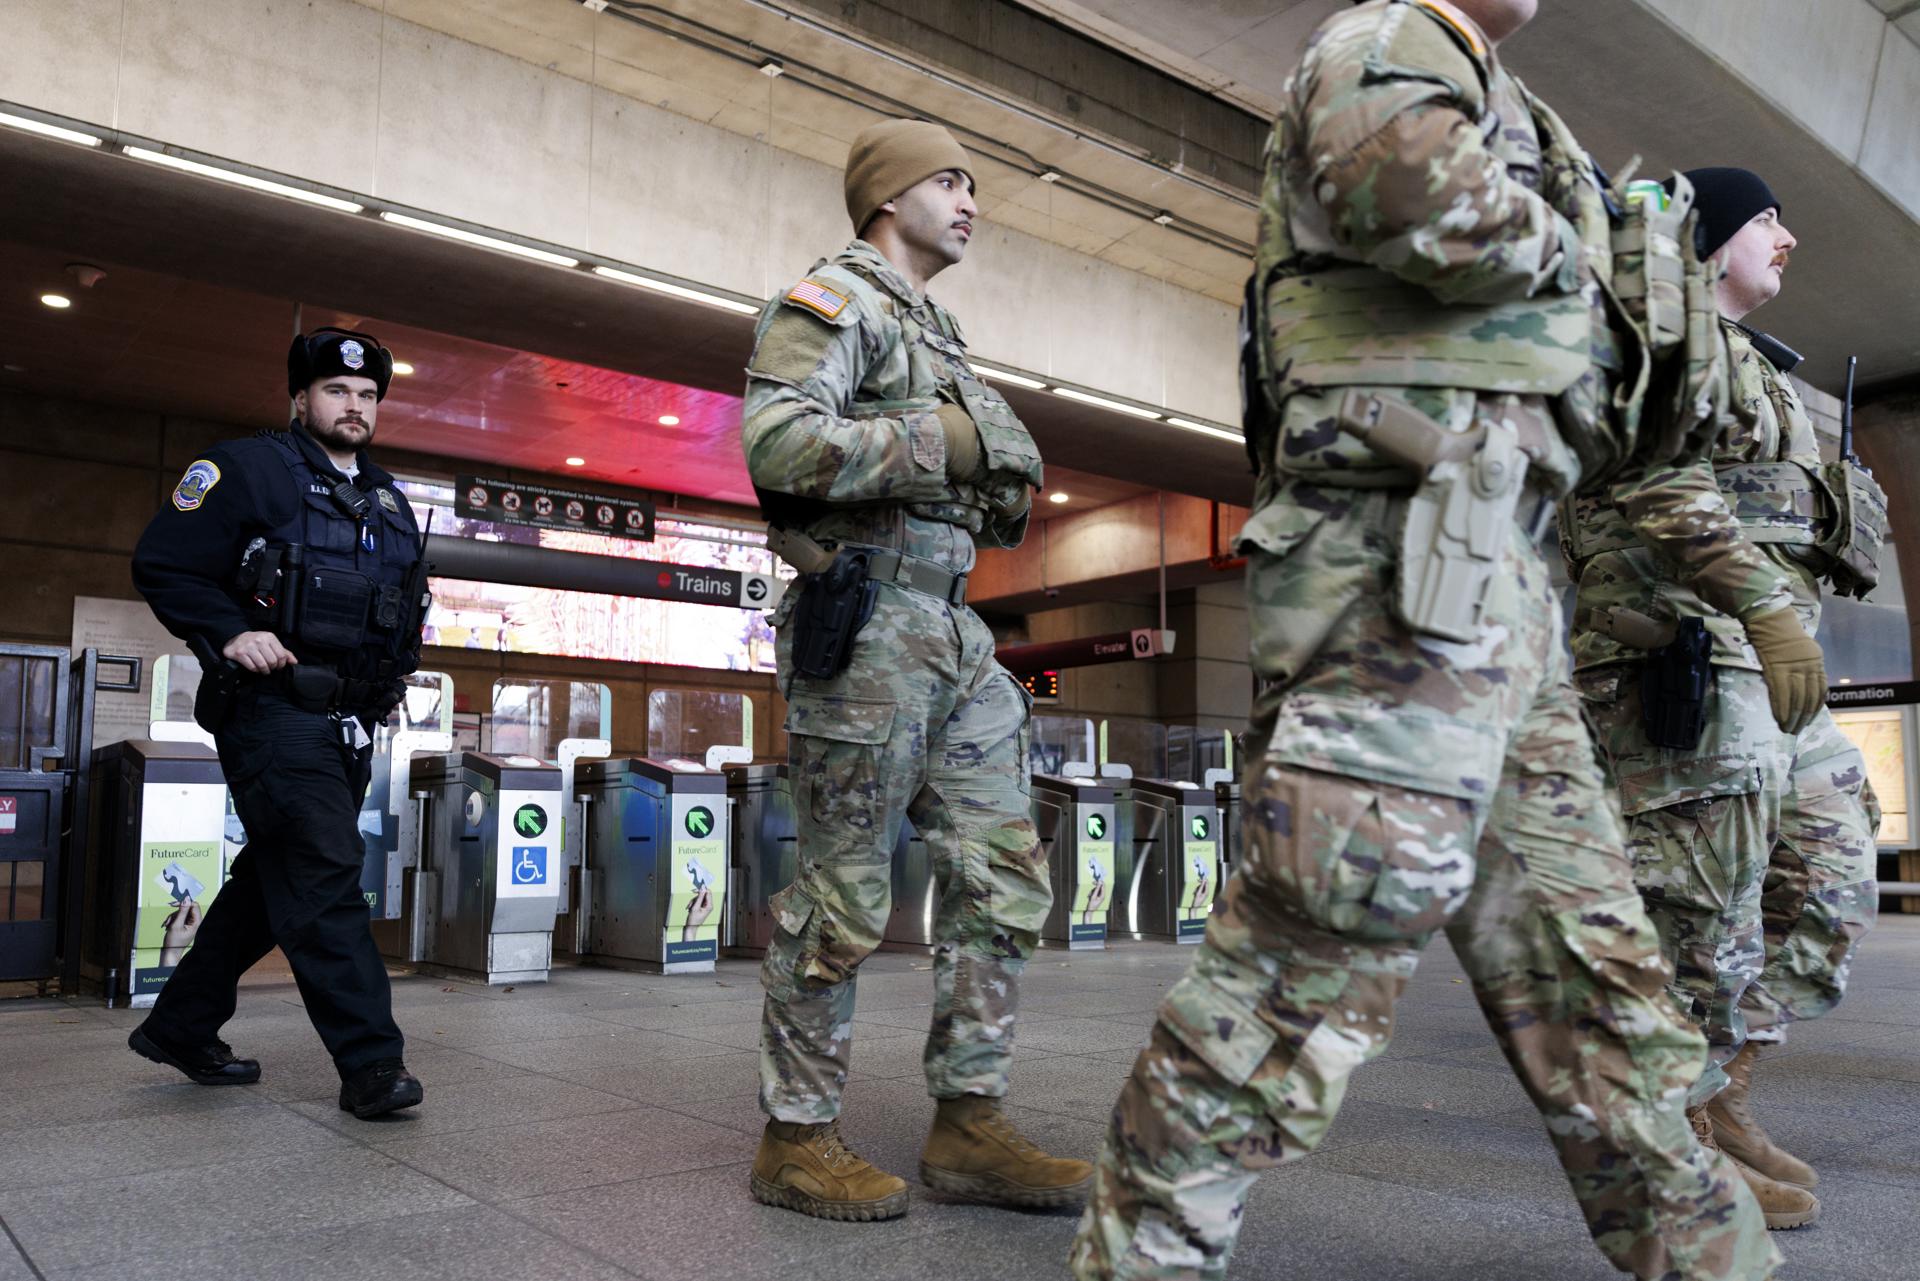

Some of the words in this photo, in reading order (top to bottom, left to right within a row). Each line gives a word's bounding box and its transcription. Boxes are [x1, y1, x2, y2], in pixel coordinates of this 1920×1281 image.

[488, 480, 515, 490] following
[676, 572, 732, 597] Trains
[151, 847, 209, 859] FutureCard
